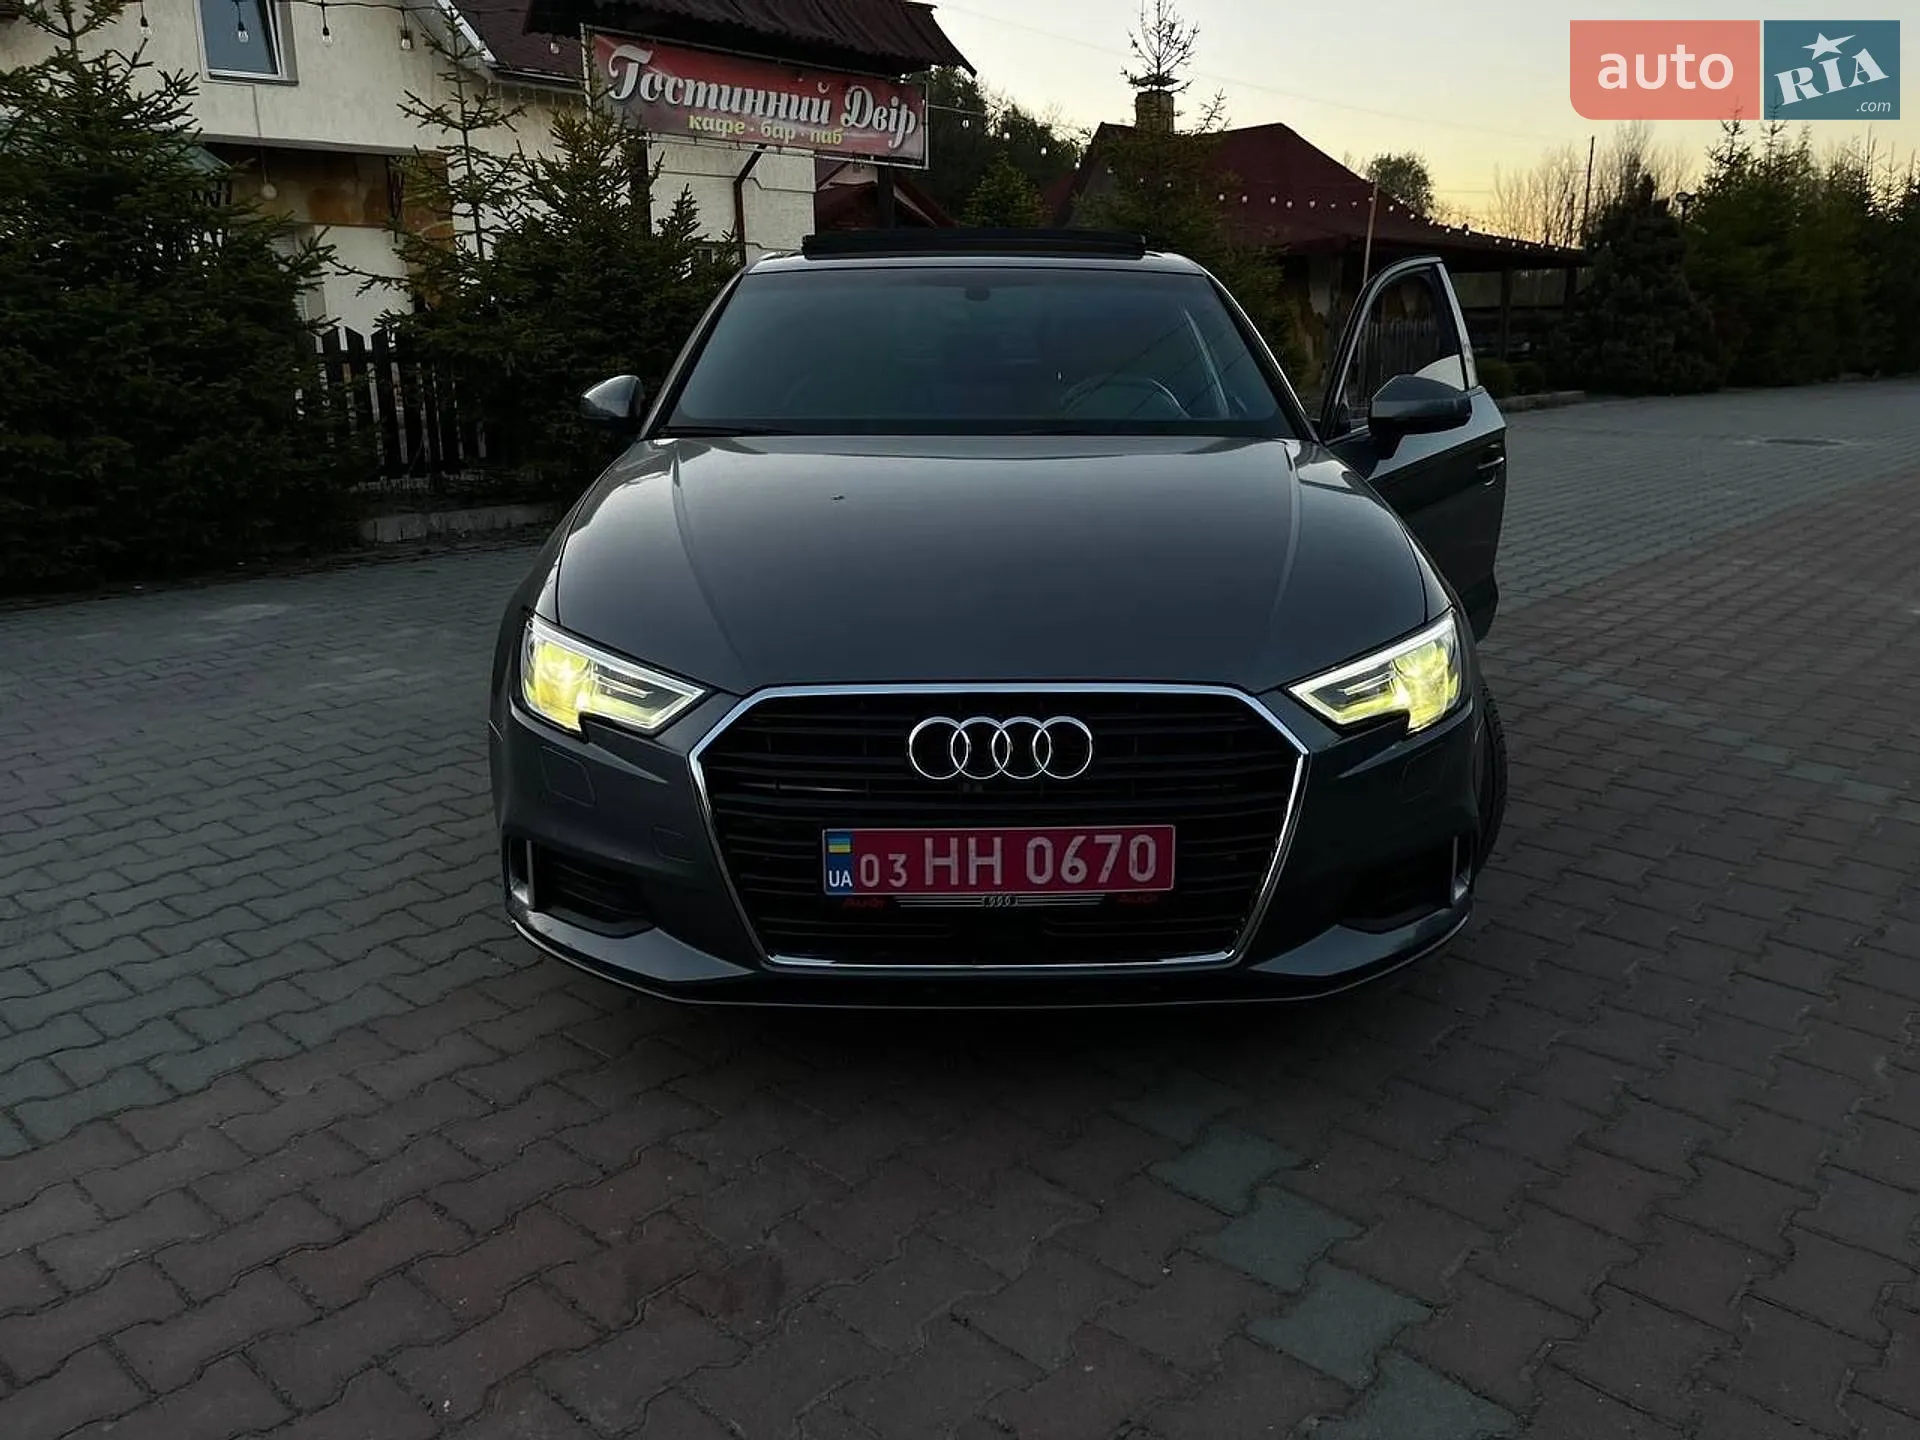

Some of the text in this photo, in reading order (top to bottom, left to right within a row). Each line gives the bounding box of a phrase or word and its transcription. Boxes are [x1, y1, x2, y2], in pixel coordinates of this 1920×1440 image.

[608, 44, 916, 148] Гостинний Двір
[688, 115, 844, 145] кафе бар паб
[828, 869, 852, 888] UA
[860, 833, 1157, 888] 03 HH 0670
